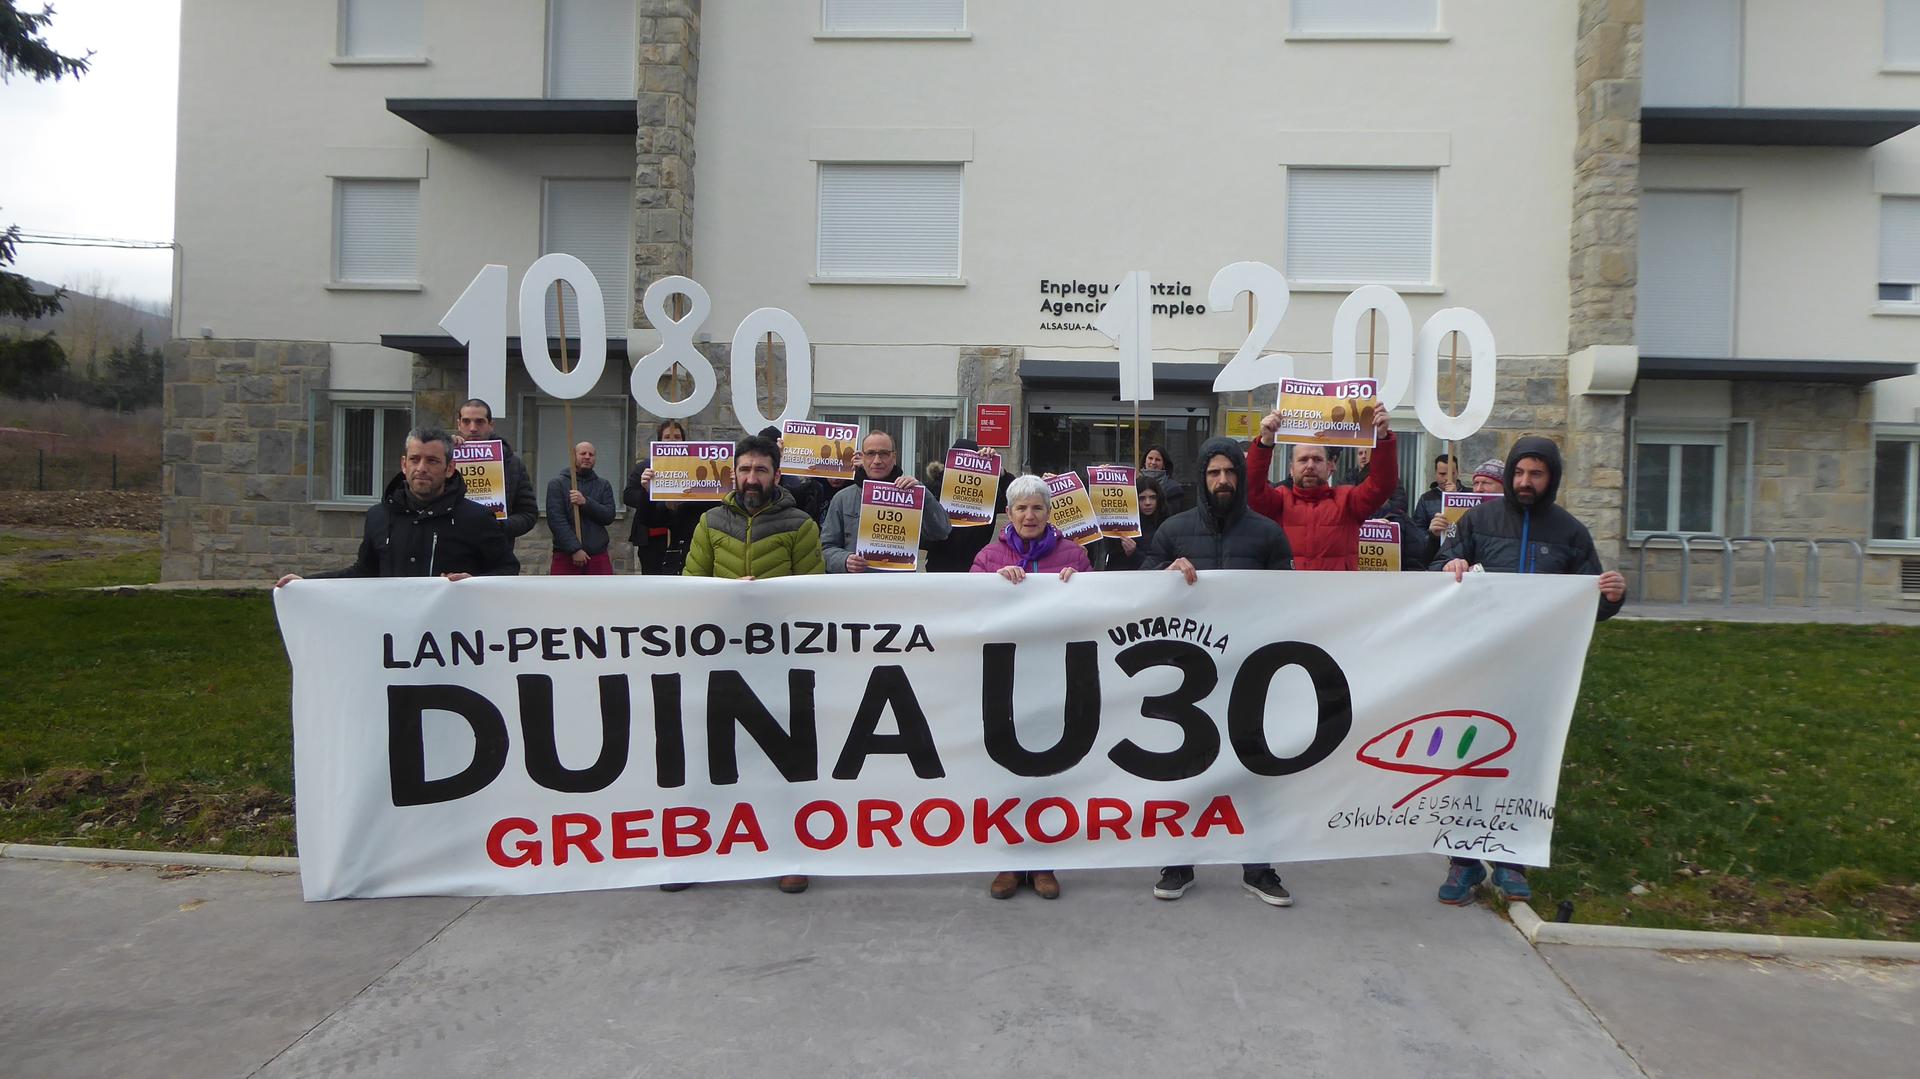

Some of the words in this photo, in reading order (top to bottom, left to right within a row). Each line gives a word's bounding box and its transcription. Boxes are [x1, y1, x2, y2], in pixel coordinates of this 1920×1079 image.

[1040, 280, 1109, 298] Enplegu
[1152, 301, 1206, 318] mpleo
[1285, 384, 1324, 395] DUINA
[1336, 384, 1372, 399] U30
[1281, 409, 1322, 419] GAZTEOK
[1280, 419, 1310, 429] GREBA
[1311, 421, 1361, 431] OROKORRA
[786, 425, 817, 435] DUINA
[825, 427, 854, 440] U30
[452, 448, 494, 459] DUINA
[656, 447, 689, 456] DUINA
[698, 447, 729, 460] U30
[783, 447, 815, 456] GAZTEOK
[955, 456, 993, 471] DUINA
[460, 465, 486, 477] U30
[654, 470, 689, 479] GAZTEOK
[1096, 471, 1129, 482] DUINA
[465, 478, 492, 488] REBA
[655, 480, 680, 488] GREBA
[681, 480, 722, 488] OROKORRA
[958, 474, 982, 487] U30
[1049, 479, 1076, 493] UINA
[872, 489, 915, 505] DUINA
[954, 486, 984, 499] GREBA
[1102, 488, 1124, 498] U30
[1051, 496, 1074, 510] U30
[1100, 499, 1129, 508] GREBA
[1447, 498, 1482, 507] DUINA
[877, 510, 903, 522] U30
[1053, 505, 1082, 521] GREBA
[872, 523, 906, 536] GREBA
[871, 533, 906, 542] OROKORRA
[1360, 545, 1385, 556] U30
[1107, 616, 1230, 655] URTARRILA
[383, 622, 935, 670] LAN-PENTSIO-BIZITZA
[387, 665, 946, 807] DUINA
[982, 640, 1353, 781] U30
[1418, 795, 1483, 812] EUSKAL
[1494, 798, 1555, 820] HERRIKO
[1328, 806, 1417, 829] eskubide
[486, 802, 769, 868] GREBA
[794, 795, 1245, 851] OROKORRA
